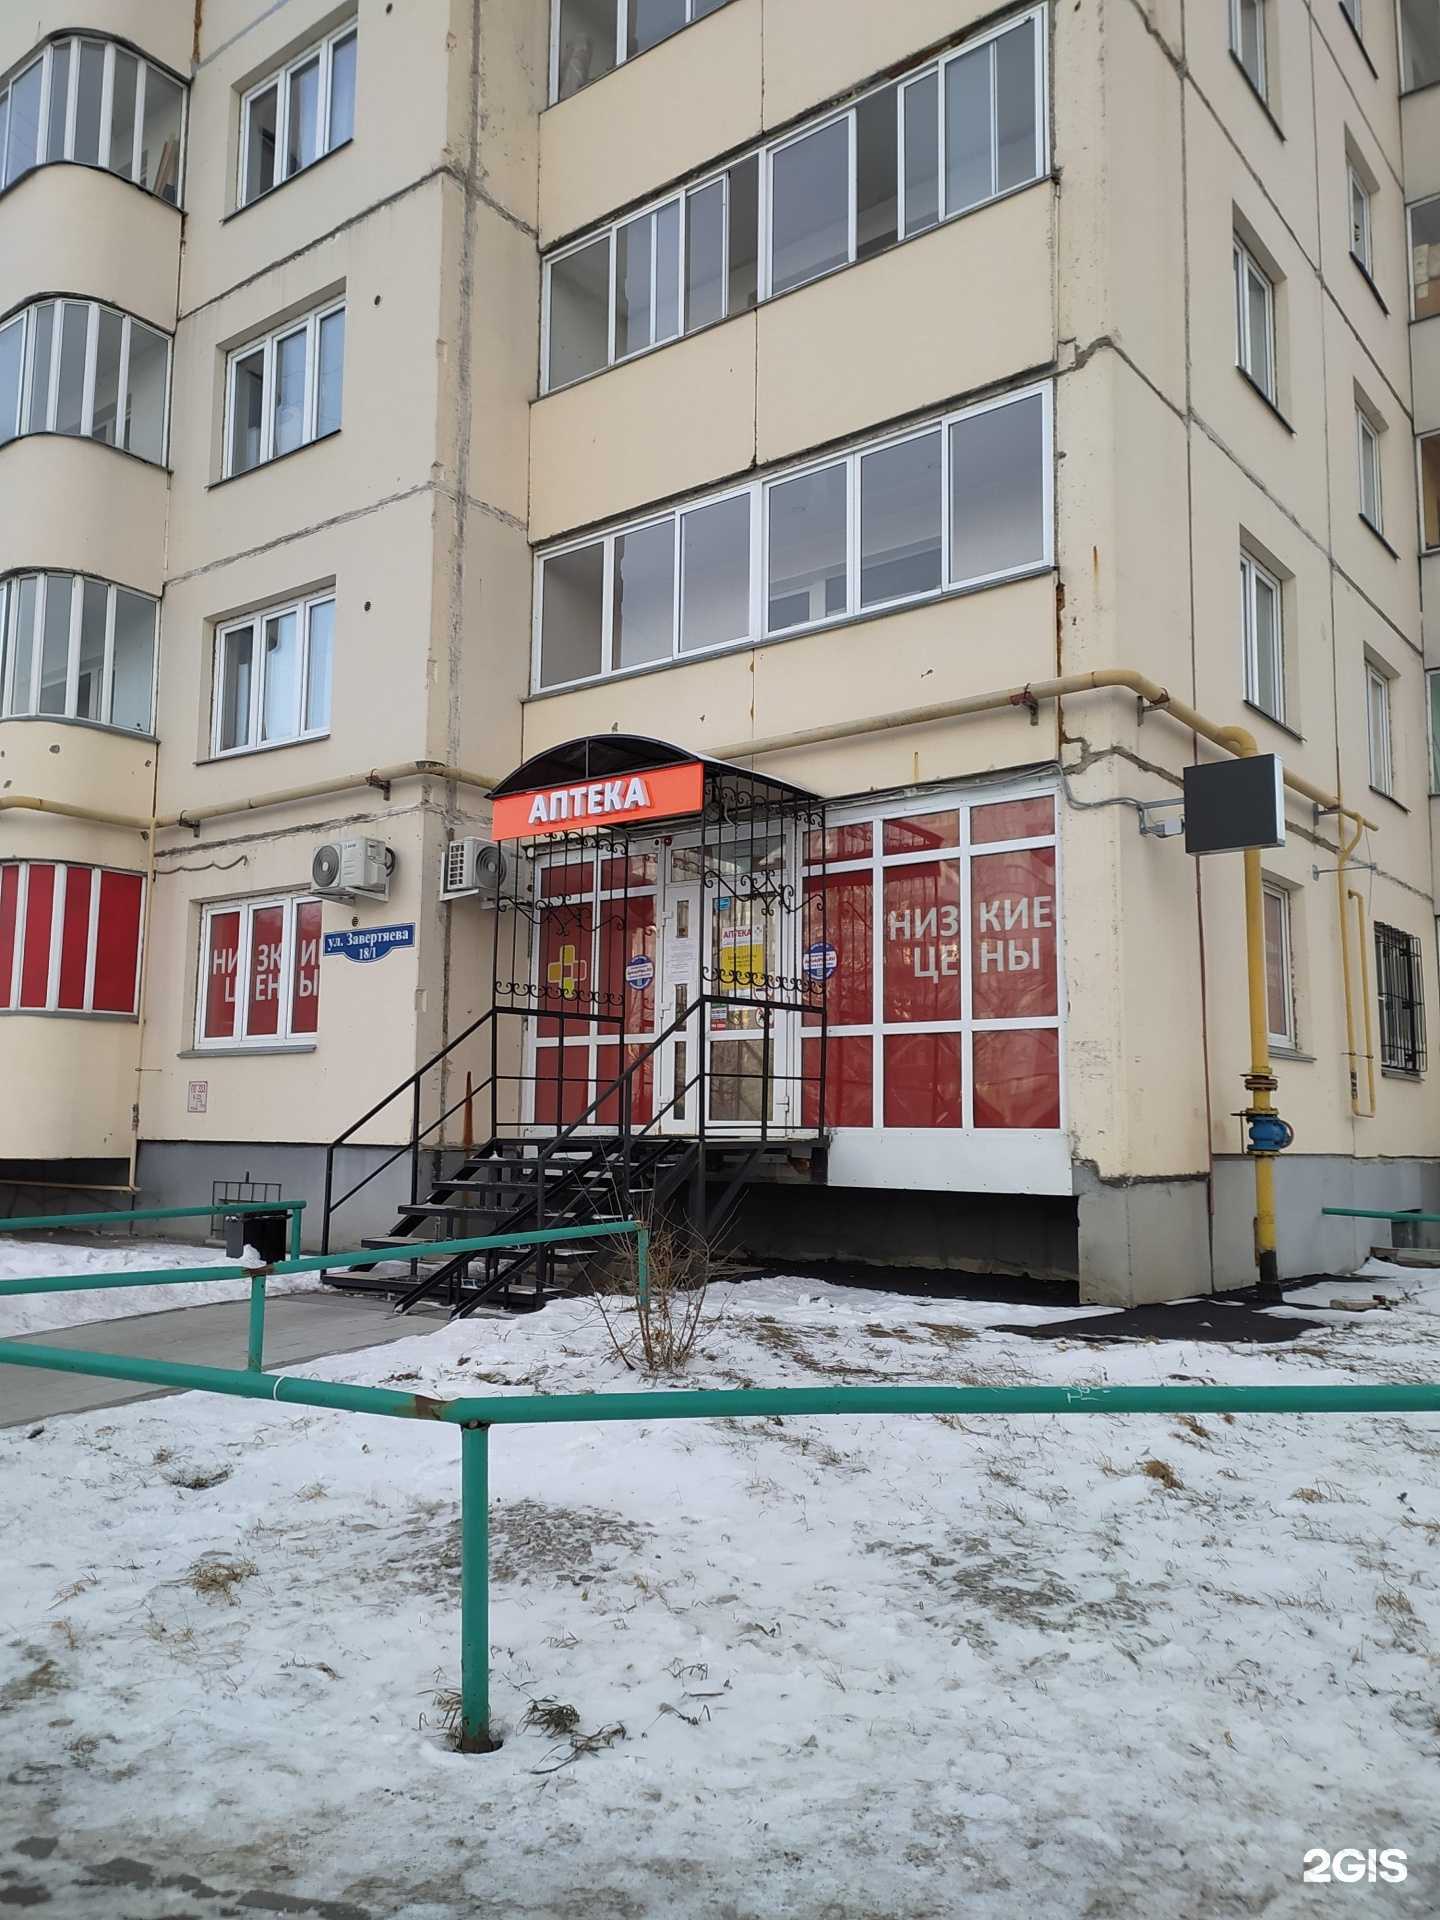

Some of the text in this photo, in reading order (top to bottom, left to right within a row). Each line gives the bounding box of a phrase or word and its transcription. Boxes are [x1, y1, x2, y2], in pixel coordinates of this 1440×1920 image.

[528, 777, 652, 824] АПТЕКА
[327, 929, 409, 952] ул. Завертяева
[359, 947, 377, 960] 18/1
